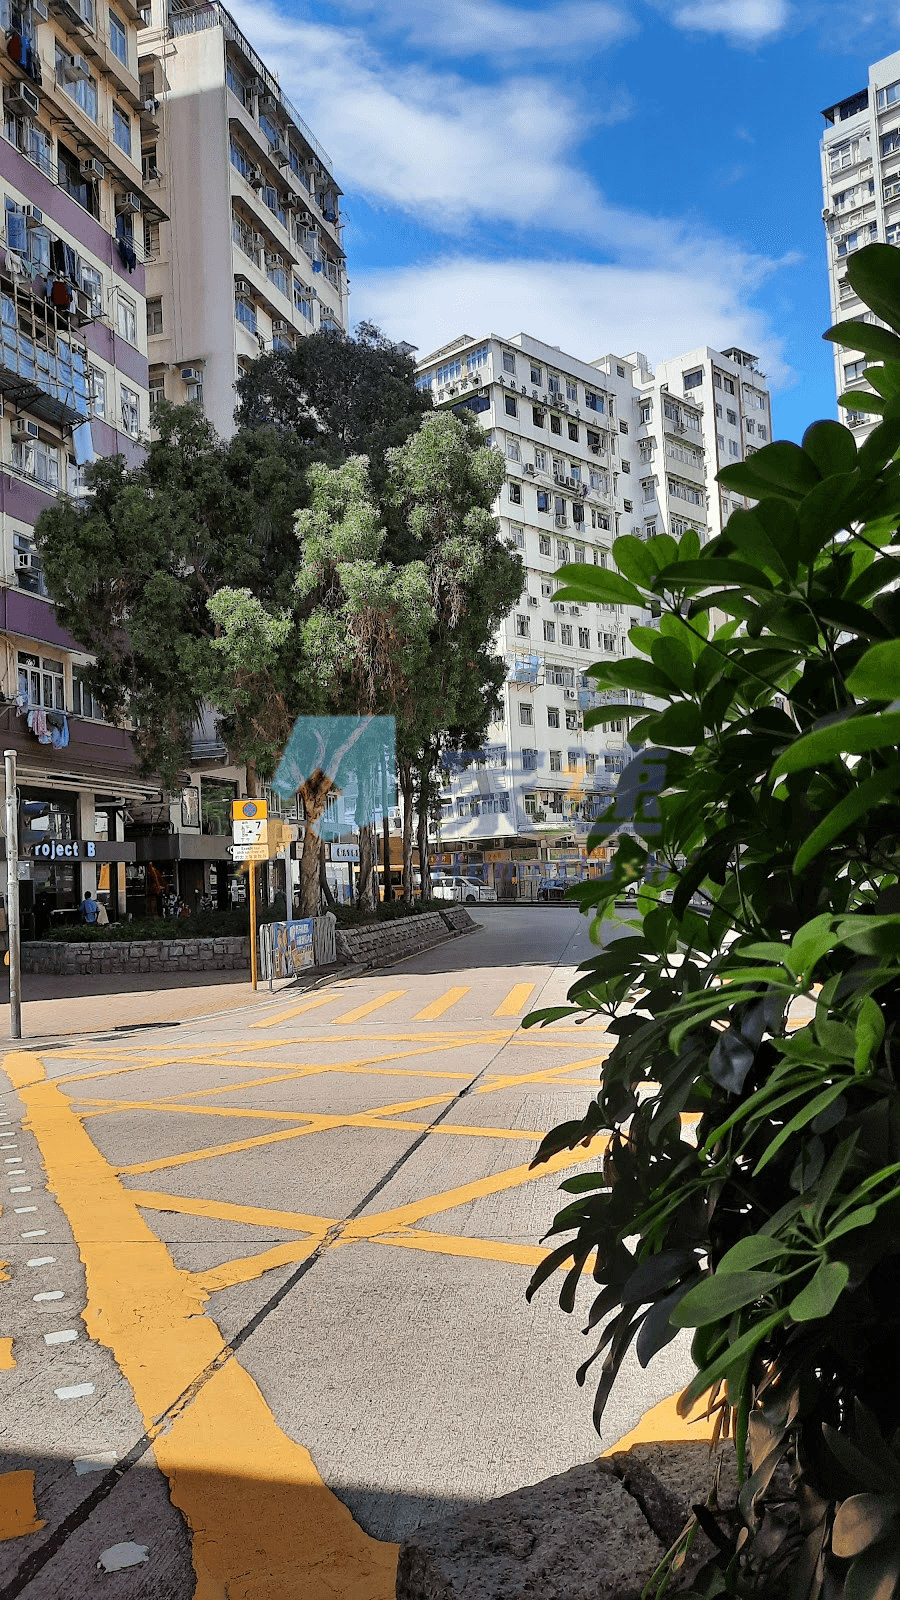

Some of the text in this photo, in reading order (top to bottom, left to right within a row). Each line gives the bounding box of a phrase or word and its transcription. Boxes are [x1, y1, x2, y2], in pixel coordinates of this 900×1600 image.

[255, 821, 261, 829] 7
[255, 833, 261, 841] 7
[32, 840, 96, 860] roject B
